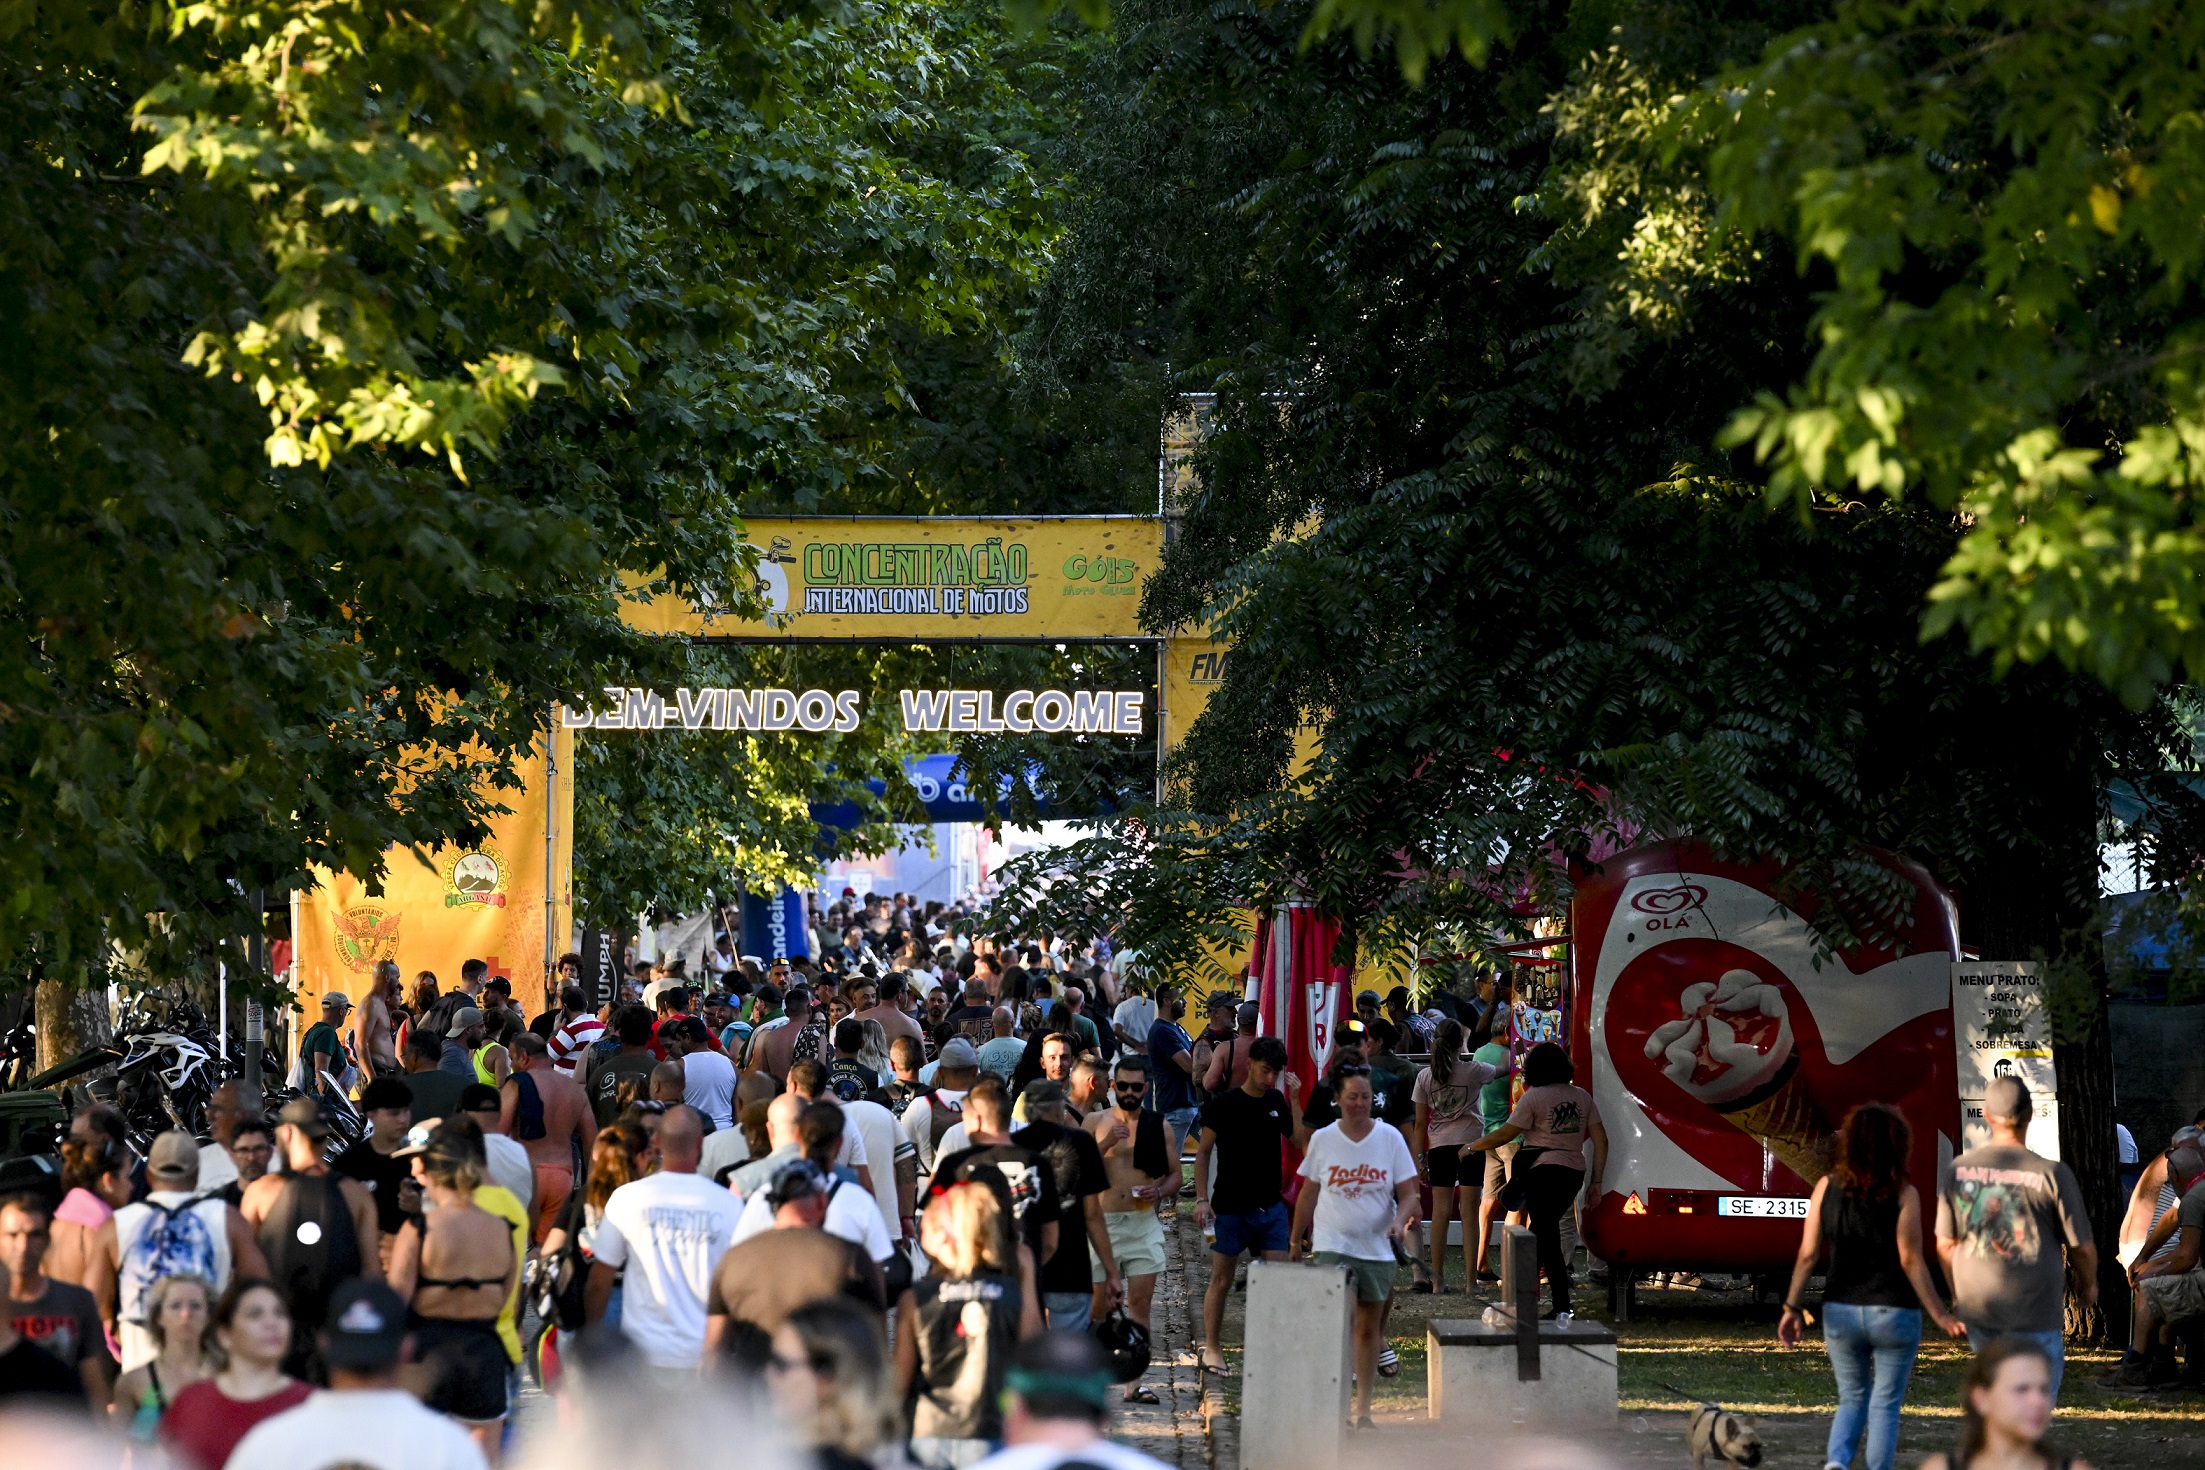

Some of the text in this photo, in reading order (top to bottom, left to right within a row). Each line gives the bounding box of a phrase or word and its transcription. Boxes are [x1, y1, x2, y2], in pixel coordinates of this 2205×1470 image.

[803, 537, 1028, 592] CONCENTRAÇÃO
[804, 587, 1029, 614] INTERNACIONAL DE MOTOS
[1189, 652, 1233, 681] FM
[900, 689, 1144, 734] WELCOME
[1645, 912, 1691, 931] OLÁ
[597, 932, 612, 1006] IUMPH
[1959, 975, 2040, 986] MENU PRATO:
[1990, 992, 2017, 1002] SOPA
[1975, 1040, 2038, 1050] SOBREMESA
[832, 1062, 858, 1073] Lança
[1731, 1200, 1754, 1214] SE
